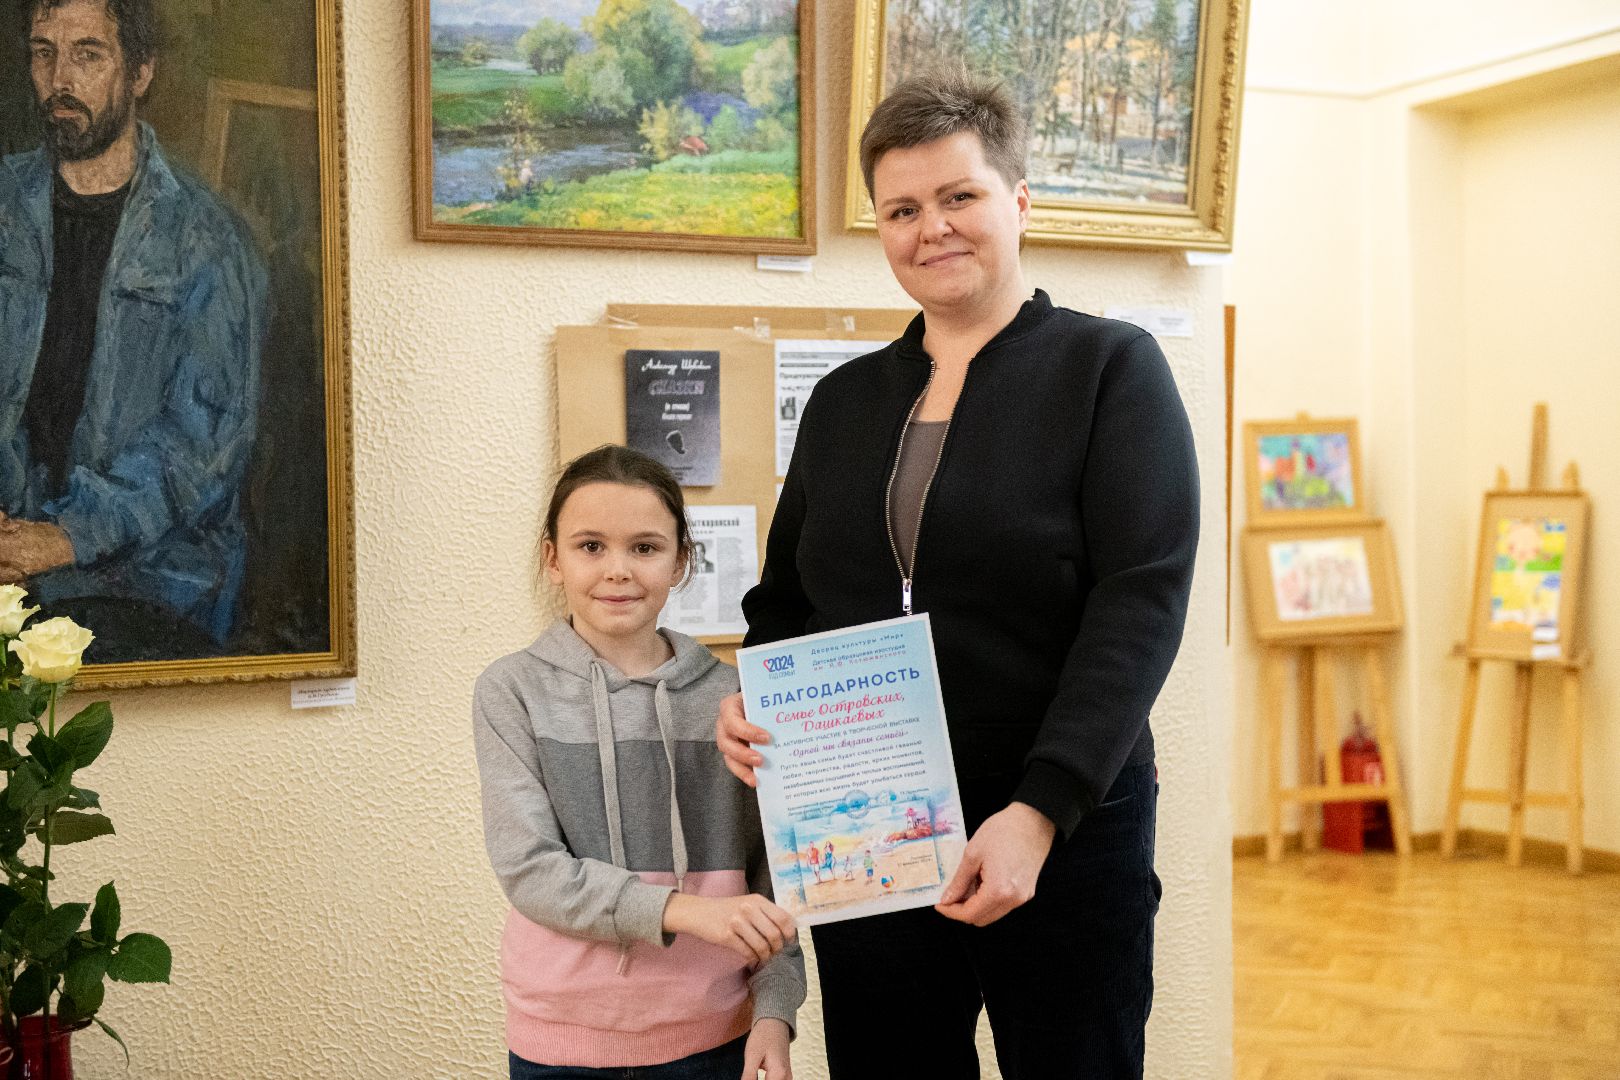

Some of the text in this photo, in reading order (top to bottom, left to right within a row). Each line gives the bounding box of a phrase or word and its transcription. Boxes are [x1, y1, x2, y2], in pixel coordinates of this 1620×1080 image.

[811, 645, 839, 655] Дворец
[842, 638, 877, 650] культуры
[768, 654, 795, 672] 2024
[760, 667, 920, 708] БЛАГОДАРНОСТЬ
[775, 692, 905, 724] Семье Островских,
[783, 736, 814, 747] АКТИВНОЕ
[816, 731, 841, 741] УЧАСТИЕ
[849, 723, 888, 735] ТВОРЧЕСКОЙ
[889, 717, 920, 728] ВЫСТАВКЕ
[802, 709, 885, 732] Дашкаевых
[837, 735, 874, 750] связаны
[780, 763, 799, 772] Пусть
[817, 756, 837, 764] семья
[837, 752, 857, 760] будет
[857, 746, 894, 756] счастливой
[843, 760, 871, 770] радости,
[793, 790, 818, 799] которых
[832, 783, 851, 791] жизнь
[852, 779, 870, 788] будет
[871, 774, 903, 785] улыбаться
